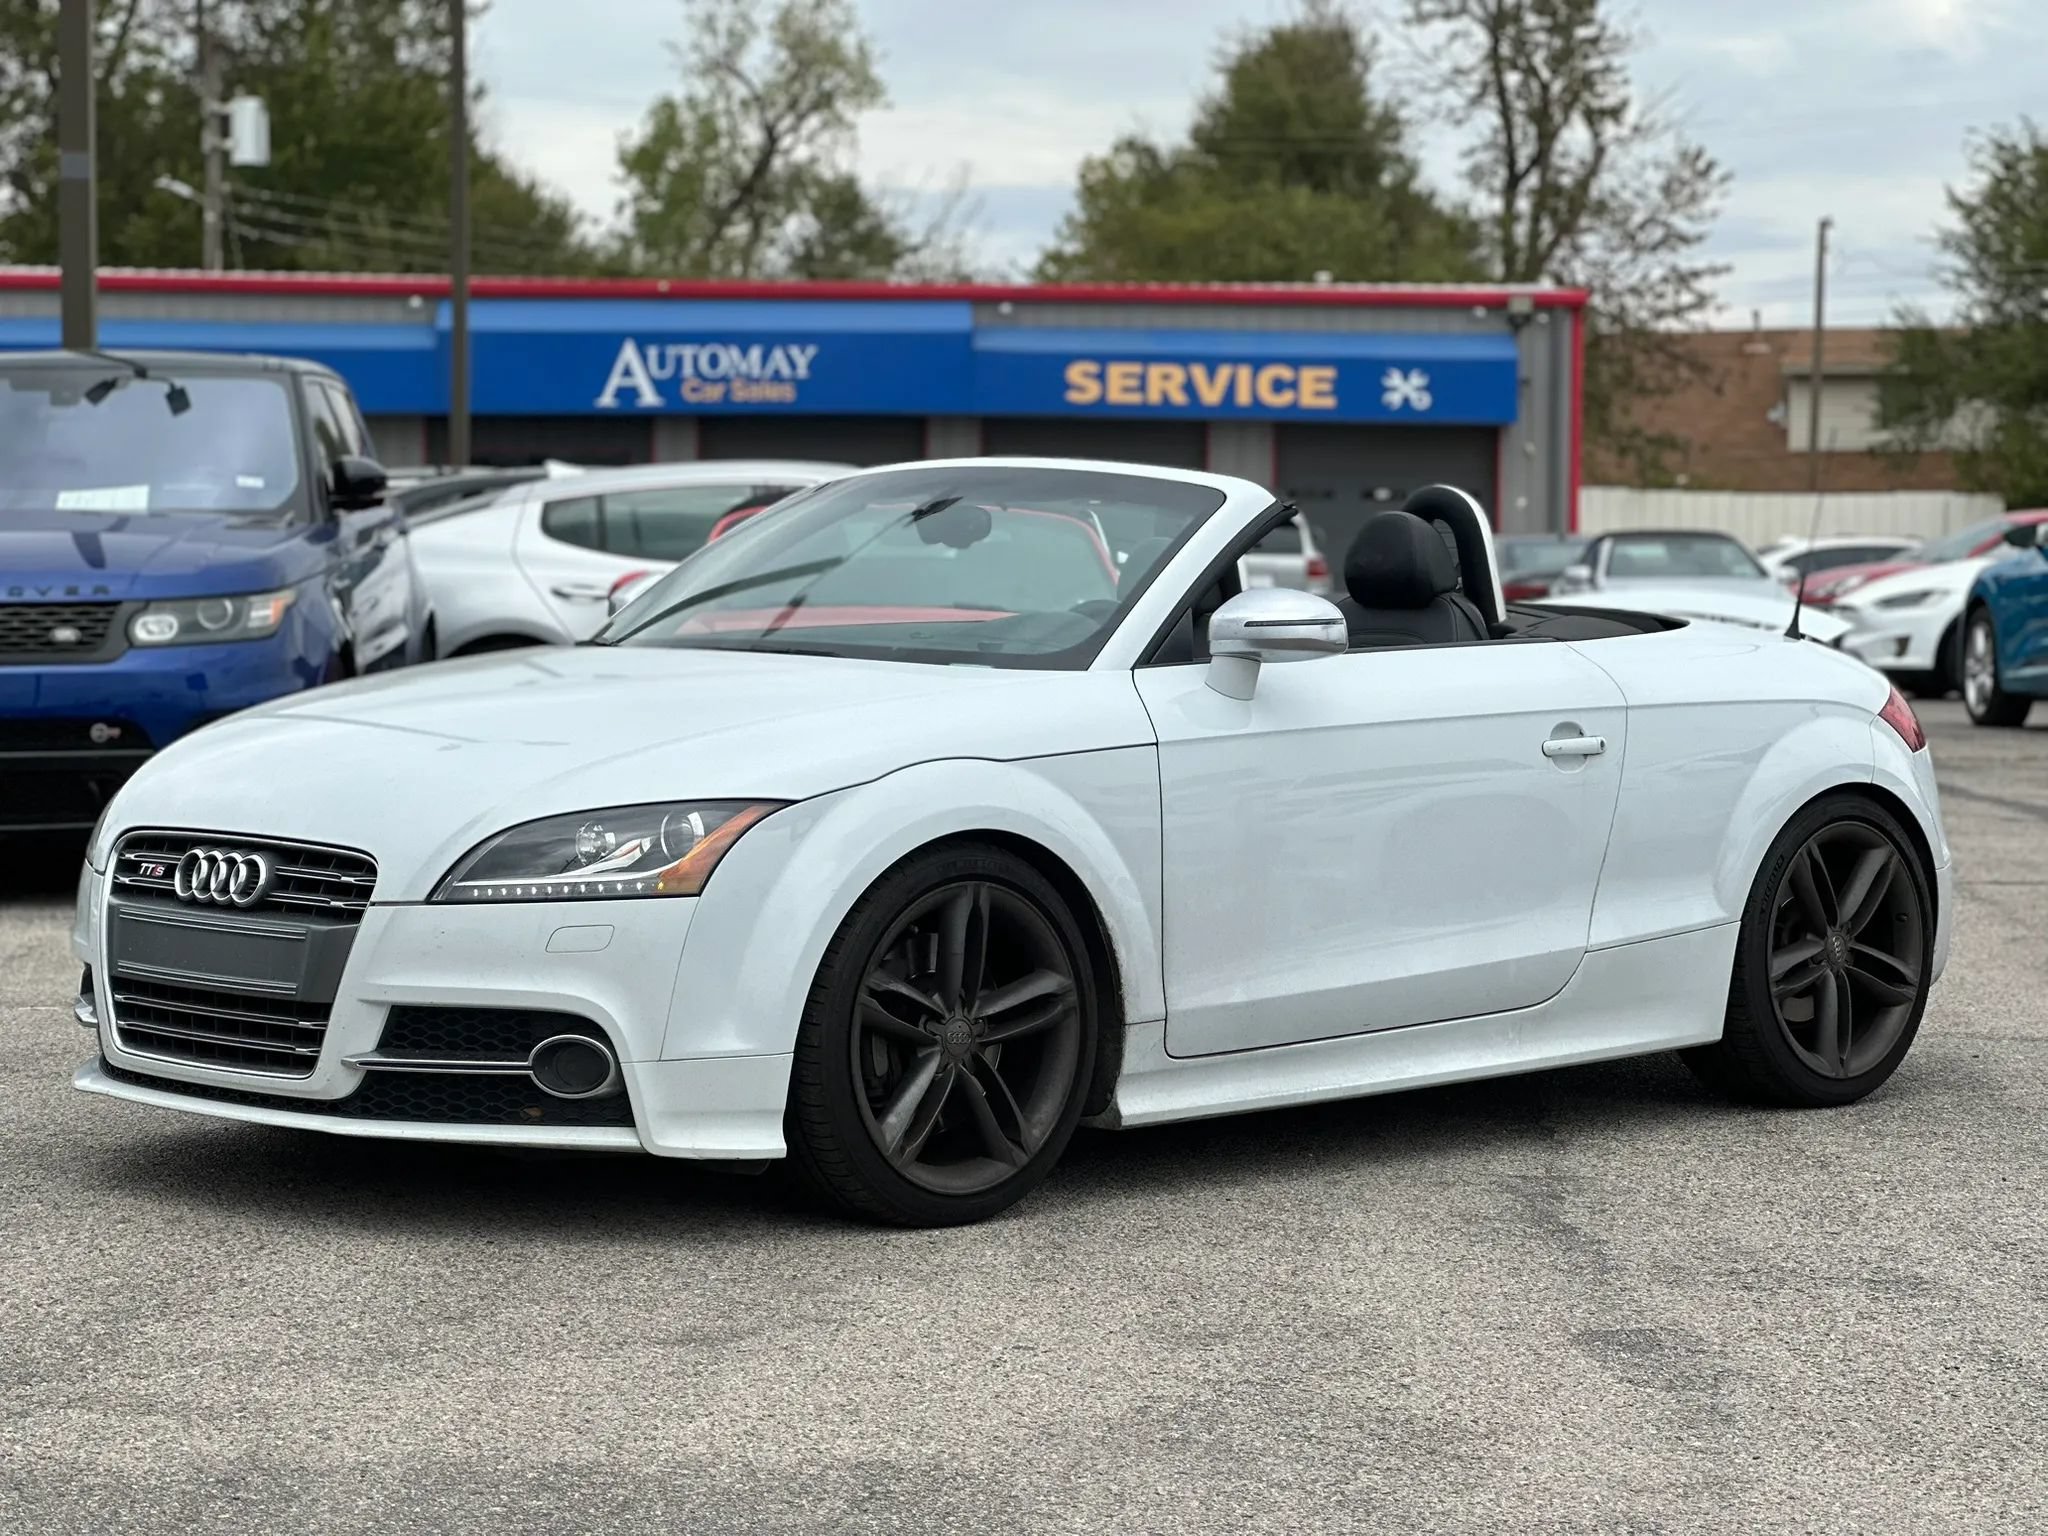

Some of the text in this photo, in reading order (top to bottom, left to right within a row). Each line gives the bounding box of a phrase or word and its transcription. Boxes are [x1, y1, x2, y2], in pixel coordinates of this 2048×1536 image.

[594, 338, 818, 407] AUTOMAY
[681, 376, 797, 403] Car Sales
[1064, 360, 1338, 410] SERVICE
[139, 862, 166, 877] TTS
